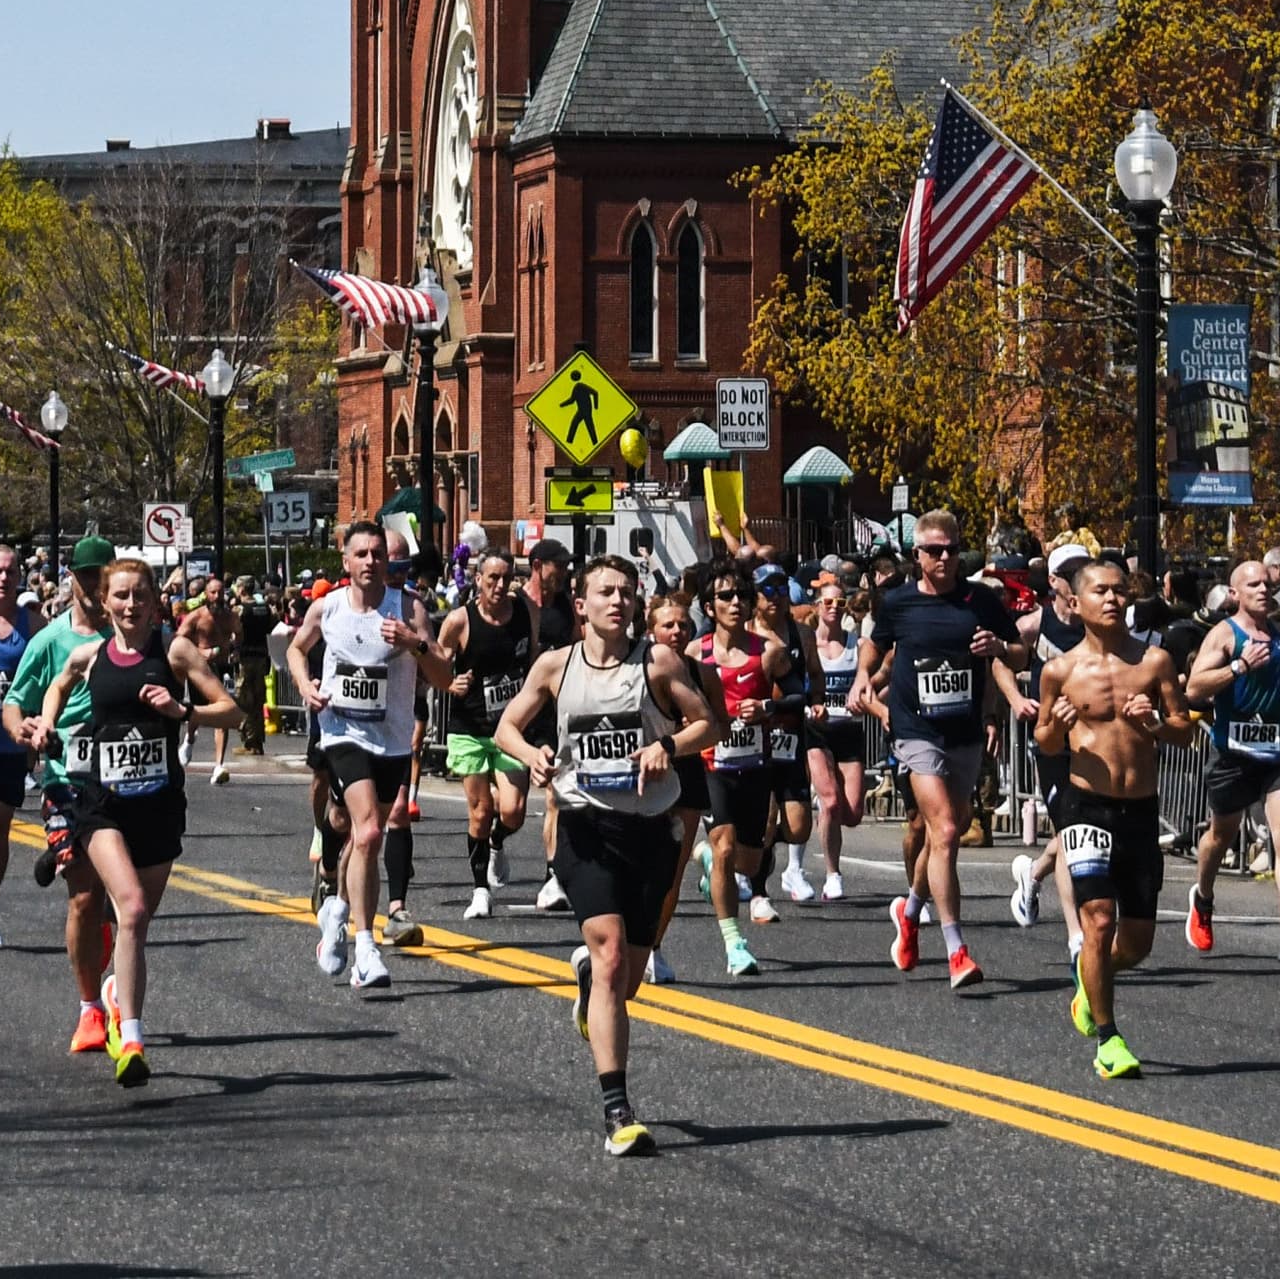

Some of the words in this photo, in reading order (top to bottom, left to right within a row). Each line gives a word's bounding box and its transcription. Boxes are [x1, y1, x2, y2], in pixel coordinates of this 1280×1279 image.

[1193, 318, 1247, 335] Natick
[1192, 334, 1248, 351] Center
[1180, 349, 1248, 367] Cultural
[1184, 364, 1248, 382] District
[720, 389, 737, 405] DO
[741, 386, 765, 405] NOT
[721, 411, 765, 426] BLOCK
[721, 431, 766, 443] INTERSECTION
[268, 500, 306, 523] 135
[342, 678, 379, 700] 9500
[923, 671, 969, 694] 10590
[107, 740, 163, 769] 12925
[576, 730, 639, 761] 10598
